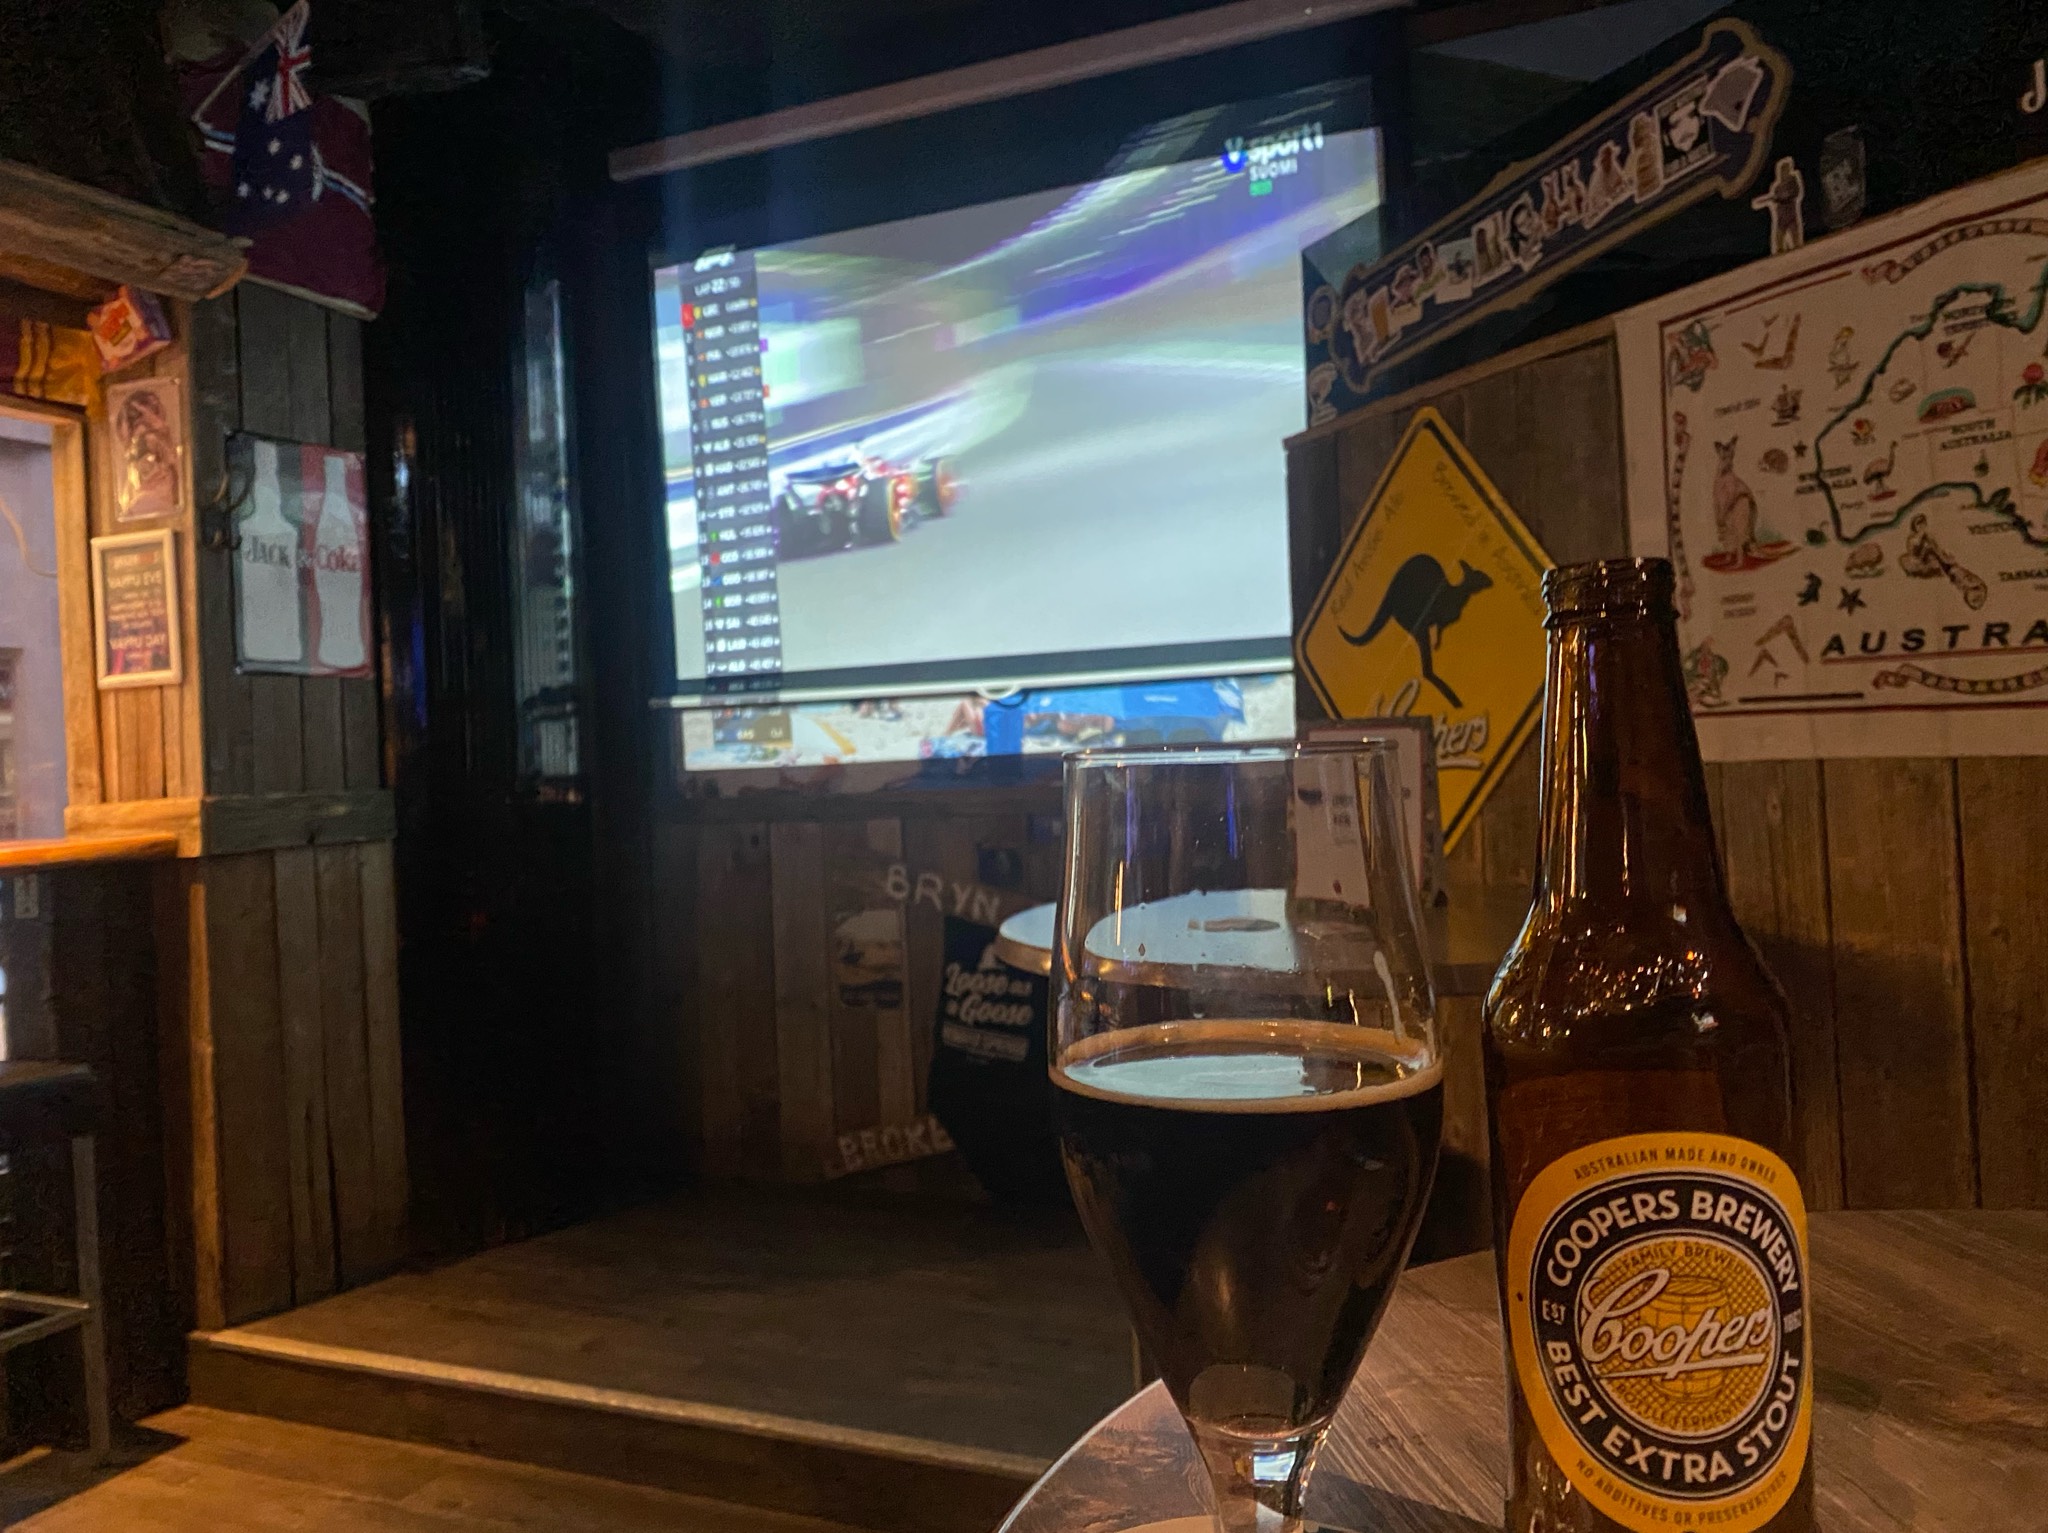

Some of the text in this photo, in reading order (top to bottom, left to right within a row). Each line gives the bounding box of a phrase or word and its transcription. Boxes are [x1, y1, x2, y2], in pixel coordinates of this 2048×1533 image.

[1820, 619, 2048, 657] AUSTRA
[887, 864, 1000, 923] BRYN
[1574, 1150, 1659, 1182] AUSTRALIAN
[1665, 1148, 1704, 1163] MADE
[1710, 1150, 1736, 1167] AND
[1547, 1189, 1799, 1294] COOPERS BREWERY
[1541, 1299, 1567, 1326] EST
[1581, 1267, 1775, 1381] Coopers
[1546, 1340, 1799, 1484] BEST EXTRA STOUT
